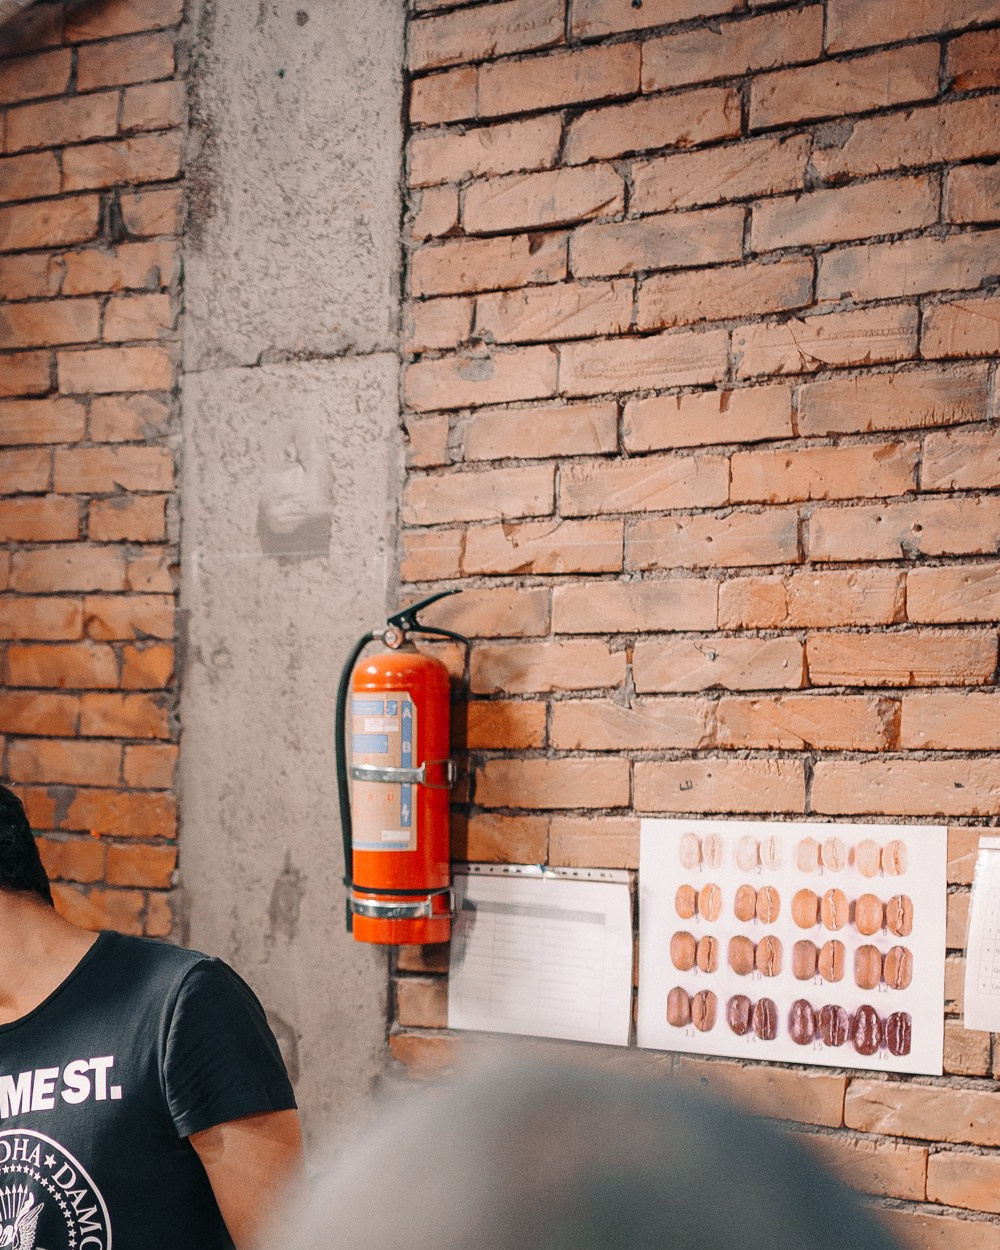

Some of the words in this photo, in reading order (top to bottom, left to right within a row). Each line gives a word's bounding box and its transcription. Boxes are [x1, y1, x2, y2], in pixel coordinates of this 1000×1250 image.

[814, 976, 823, 986] 11
[879, 1051, 889, 1060] 16
[61, 1055, 122, 1104] ST.
